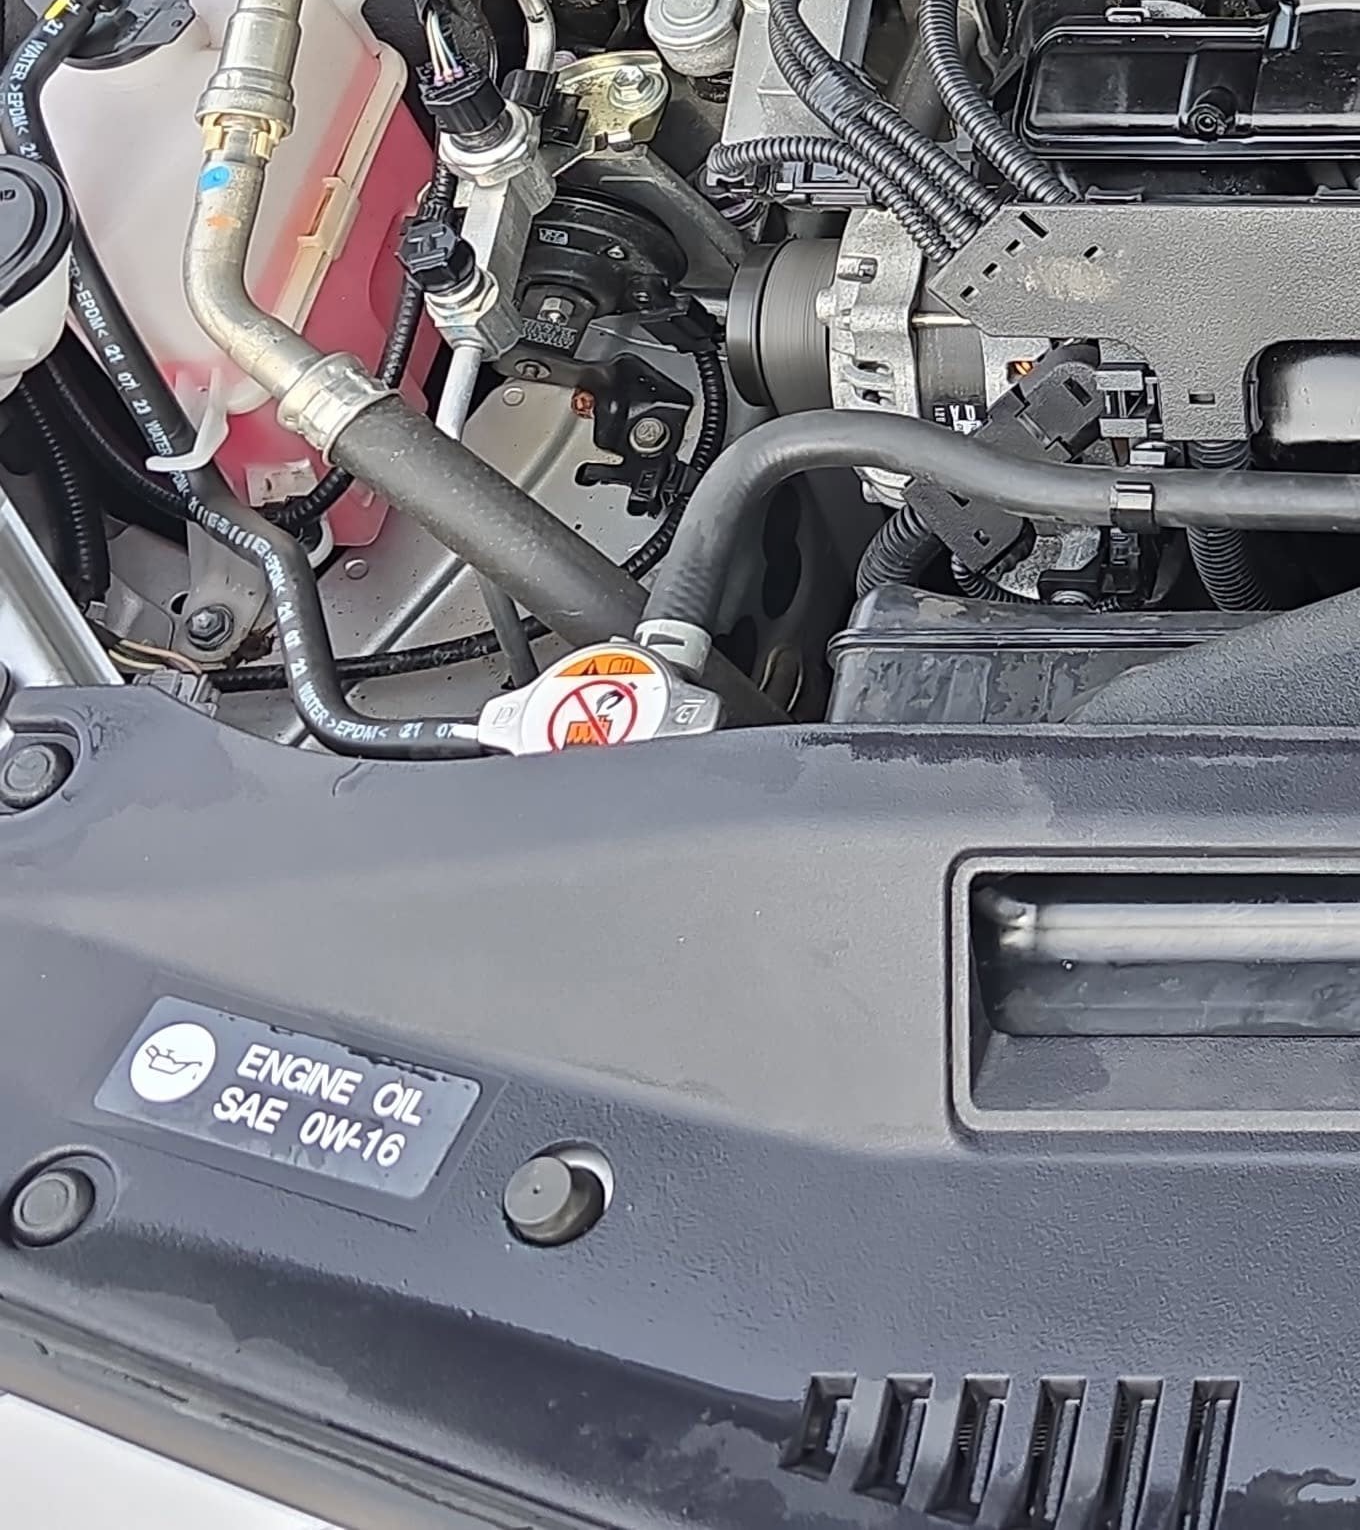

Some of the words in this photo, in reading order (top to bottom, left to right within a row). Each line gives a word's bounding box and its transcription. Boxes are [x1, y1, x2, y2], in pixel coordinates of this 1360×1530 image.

[10, 39, 47, 82] WATER
[7, 83, 29, 135] >EPDM<
[73, 281, 109, 339] >EPDM<
[145, 420, 174, 456] WATER
[299, 681, 329, 725] WATER
[328, 719, 387, 740] >EPDM<
[399, 722, 423, 739] 21
[237, 1043, 363, 1106] ENGINE
[372, 1080, 423, 1126] OIL
[213, 1086, 289, 1135] SAE
[299, 1111, 406, 1168] 0W-16
